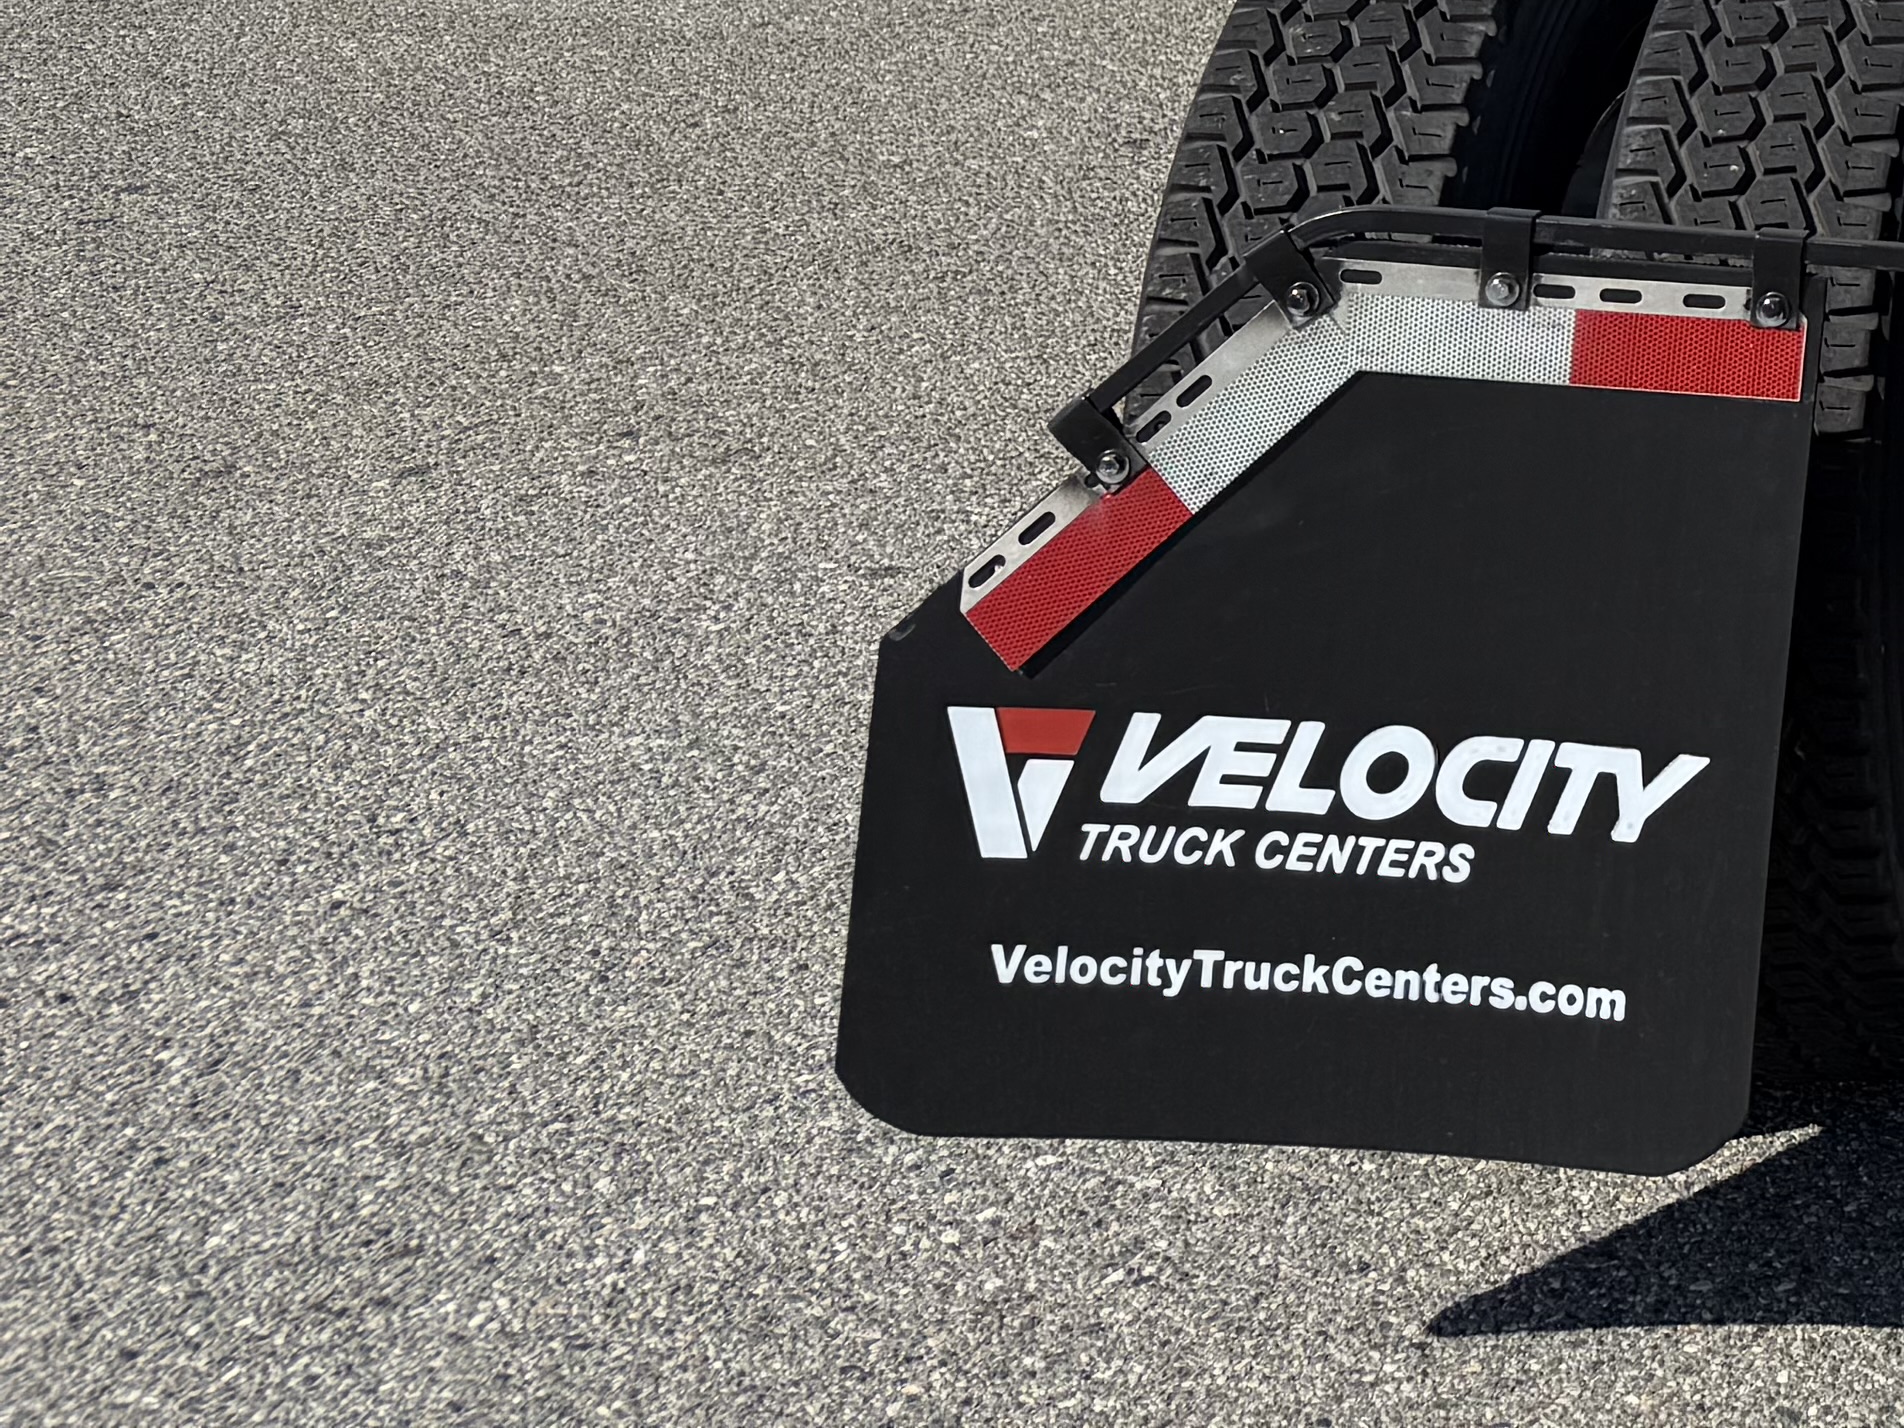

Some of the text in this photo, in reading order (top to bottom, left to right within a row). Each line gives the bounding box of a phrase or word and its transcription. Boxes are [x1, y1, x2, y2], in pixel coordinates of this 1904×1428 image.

[1099, 711, 1711, 844] VELOCITY
[1079, 823, 1476, 884] TRUCK CENTERS
[990, 943, 1627, 1022] VelocityTruckCenters.com
